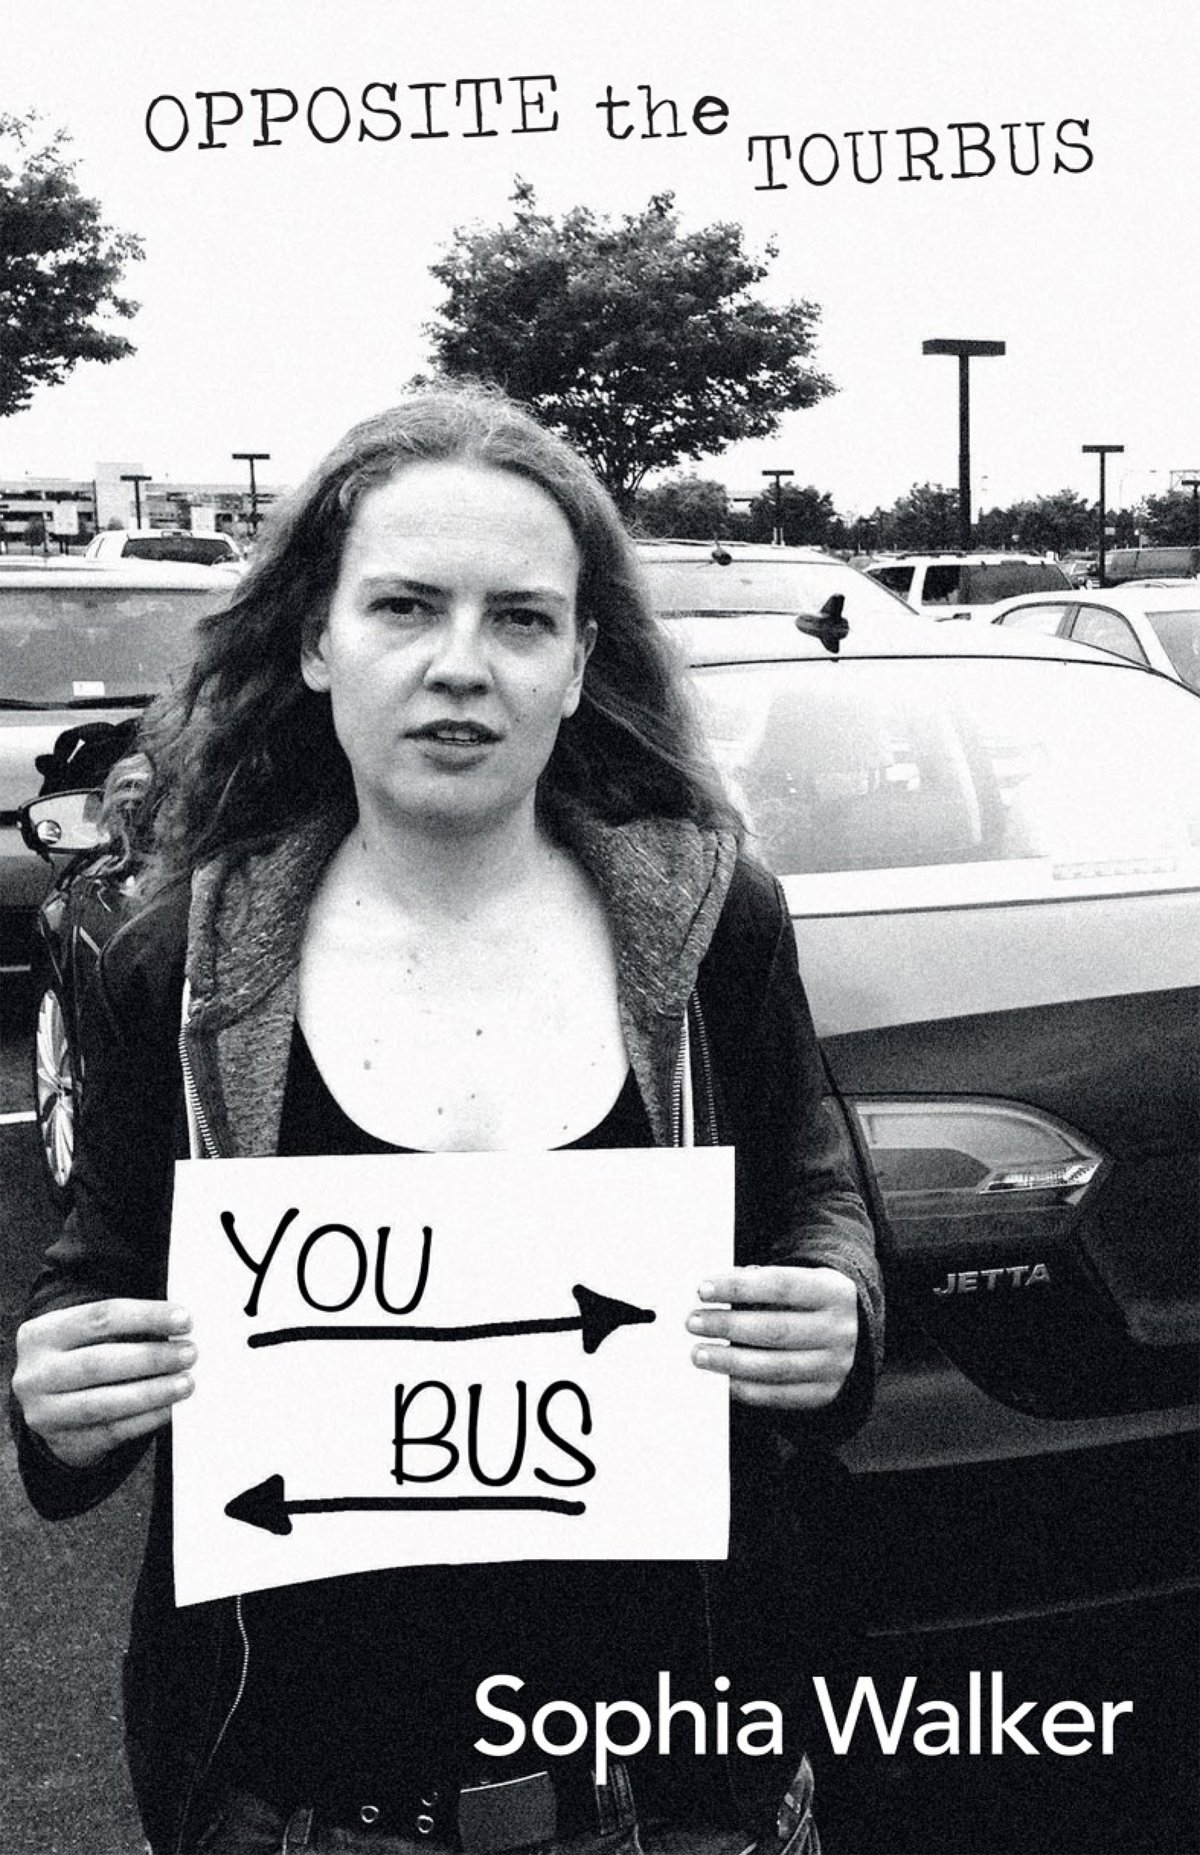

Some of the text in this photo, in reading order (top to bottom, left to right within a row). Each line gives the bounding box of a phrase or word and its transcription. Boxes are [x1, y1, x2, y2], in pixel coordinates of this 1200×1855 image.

[220, 1208, 433, 1318] YOU
[933, 1263, 1050, 1295] JETTA
[391, 1380, 597, 1487] BUS
